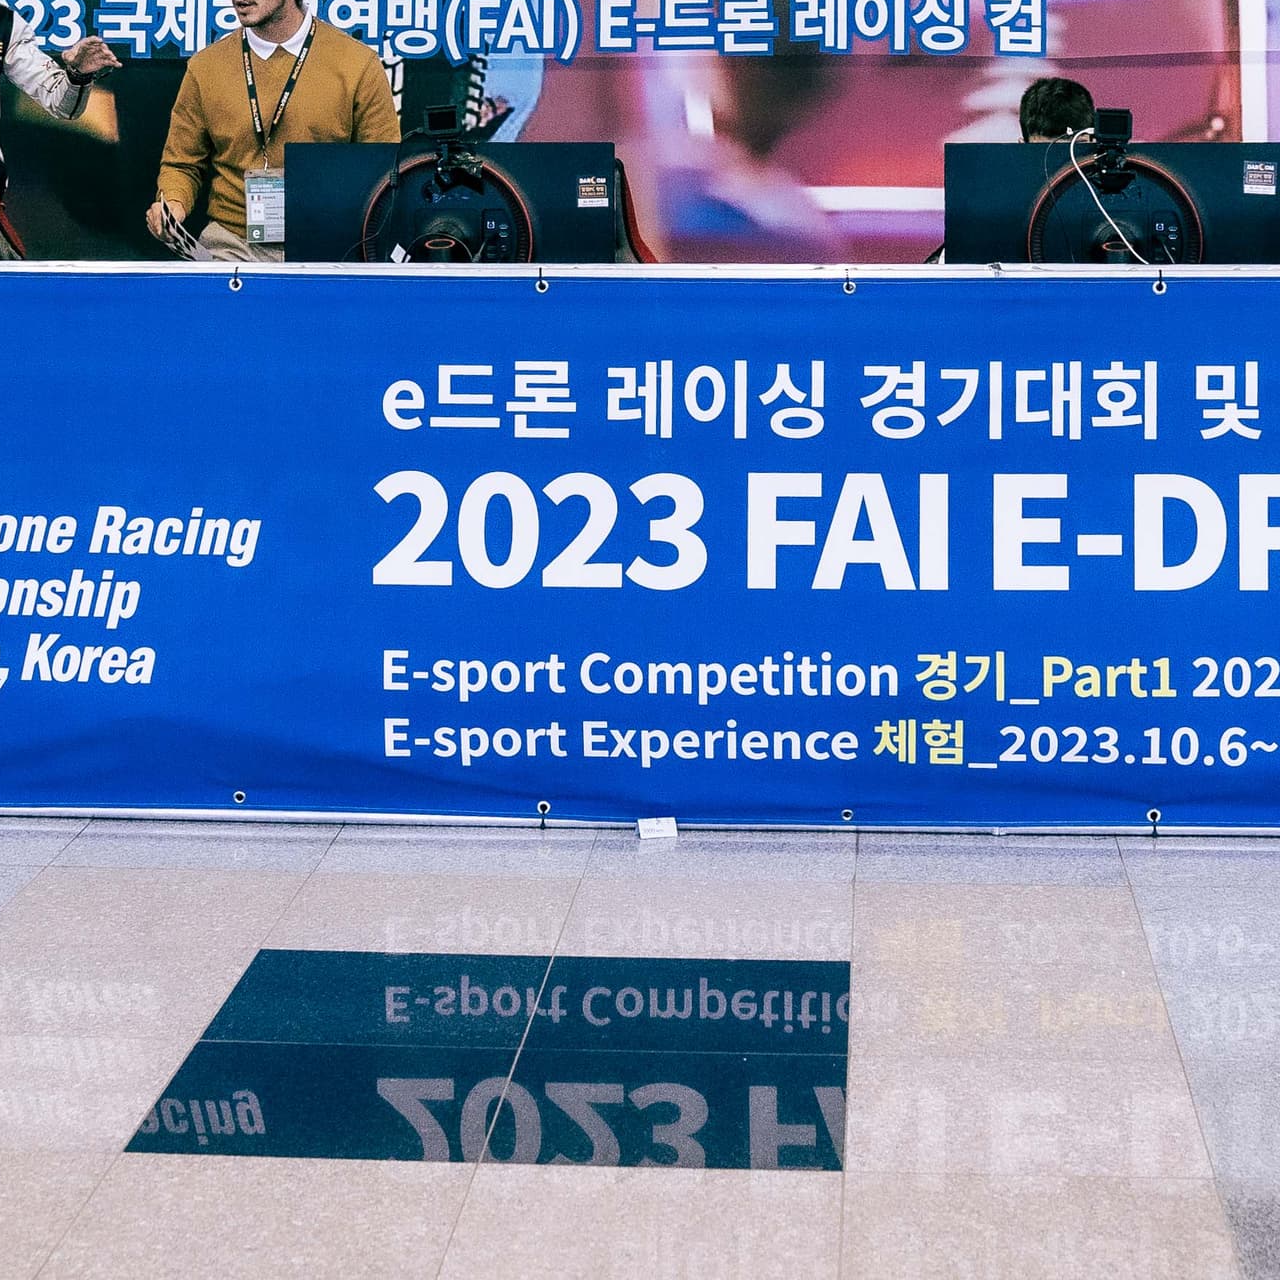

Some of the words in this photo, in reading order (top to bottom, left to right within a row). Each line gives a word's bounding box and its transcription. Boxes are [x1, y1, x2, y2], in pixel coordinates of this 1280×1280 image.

[382, 360, 577, 439] e드론
[607, 360, 825, 439] 레이싱
[860, 360, 1157, 440] 경기대회
[1195, 361, 1262, 440] 및
[88, 505, 262, 567] Racing
[372, 470, 708, 591] 2023
[747, 472, 949, 591] FAI
[21, 633, 156, 684] Korea
[383, 649, 566, 702] E-sport
[580, 651, 898, 705] Competition
[914, 651, 1177, 705] 경기_Part1
[384, 718, 567, 766] E-sport
[582, 719, 859, 768] Experience
